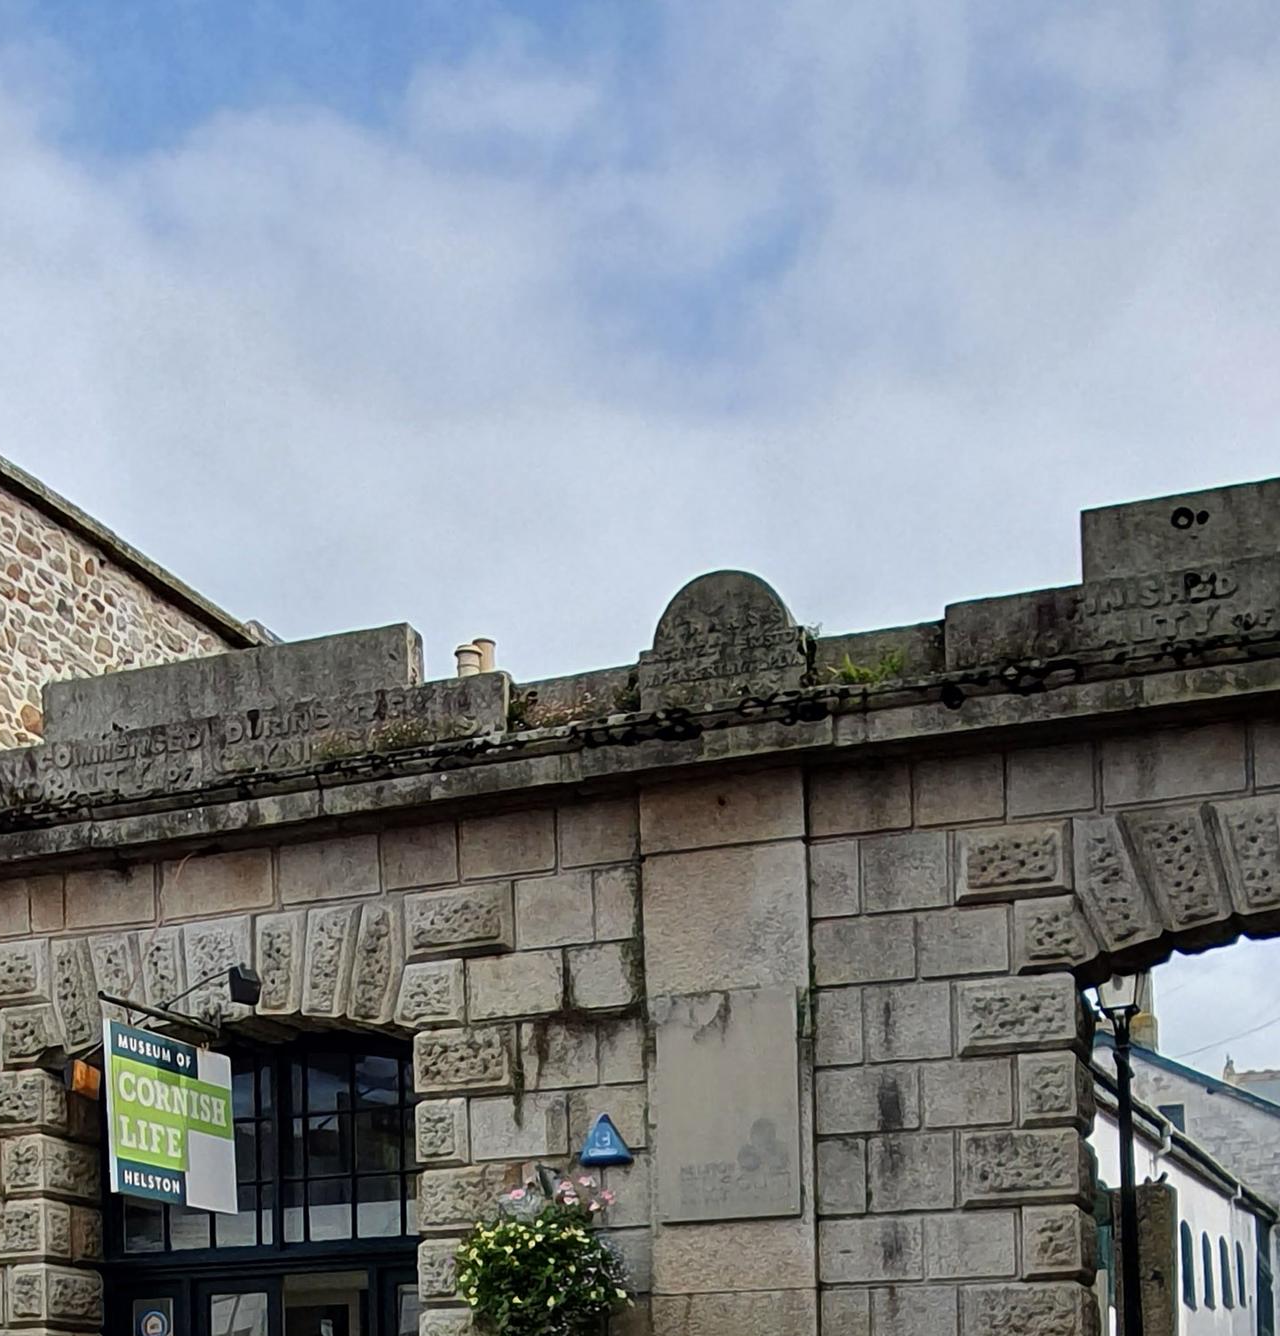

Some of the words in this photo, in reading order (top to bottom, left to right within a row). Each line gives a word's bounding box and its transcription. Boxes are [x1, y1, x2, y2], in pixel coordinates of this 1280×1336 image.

[118, 1034, 171, 1063] MUSEUM
[175, 1049, 192, 1068] OF
[118, 1071, 227, 1128] CORNISH
[119, 1115, 183, 1159] LIFE
[124, 1169, 181, 1195] HELSTON
